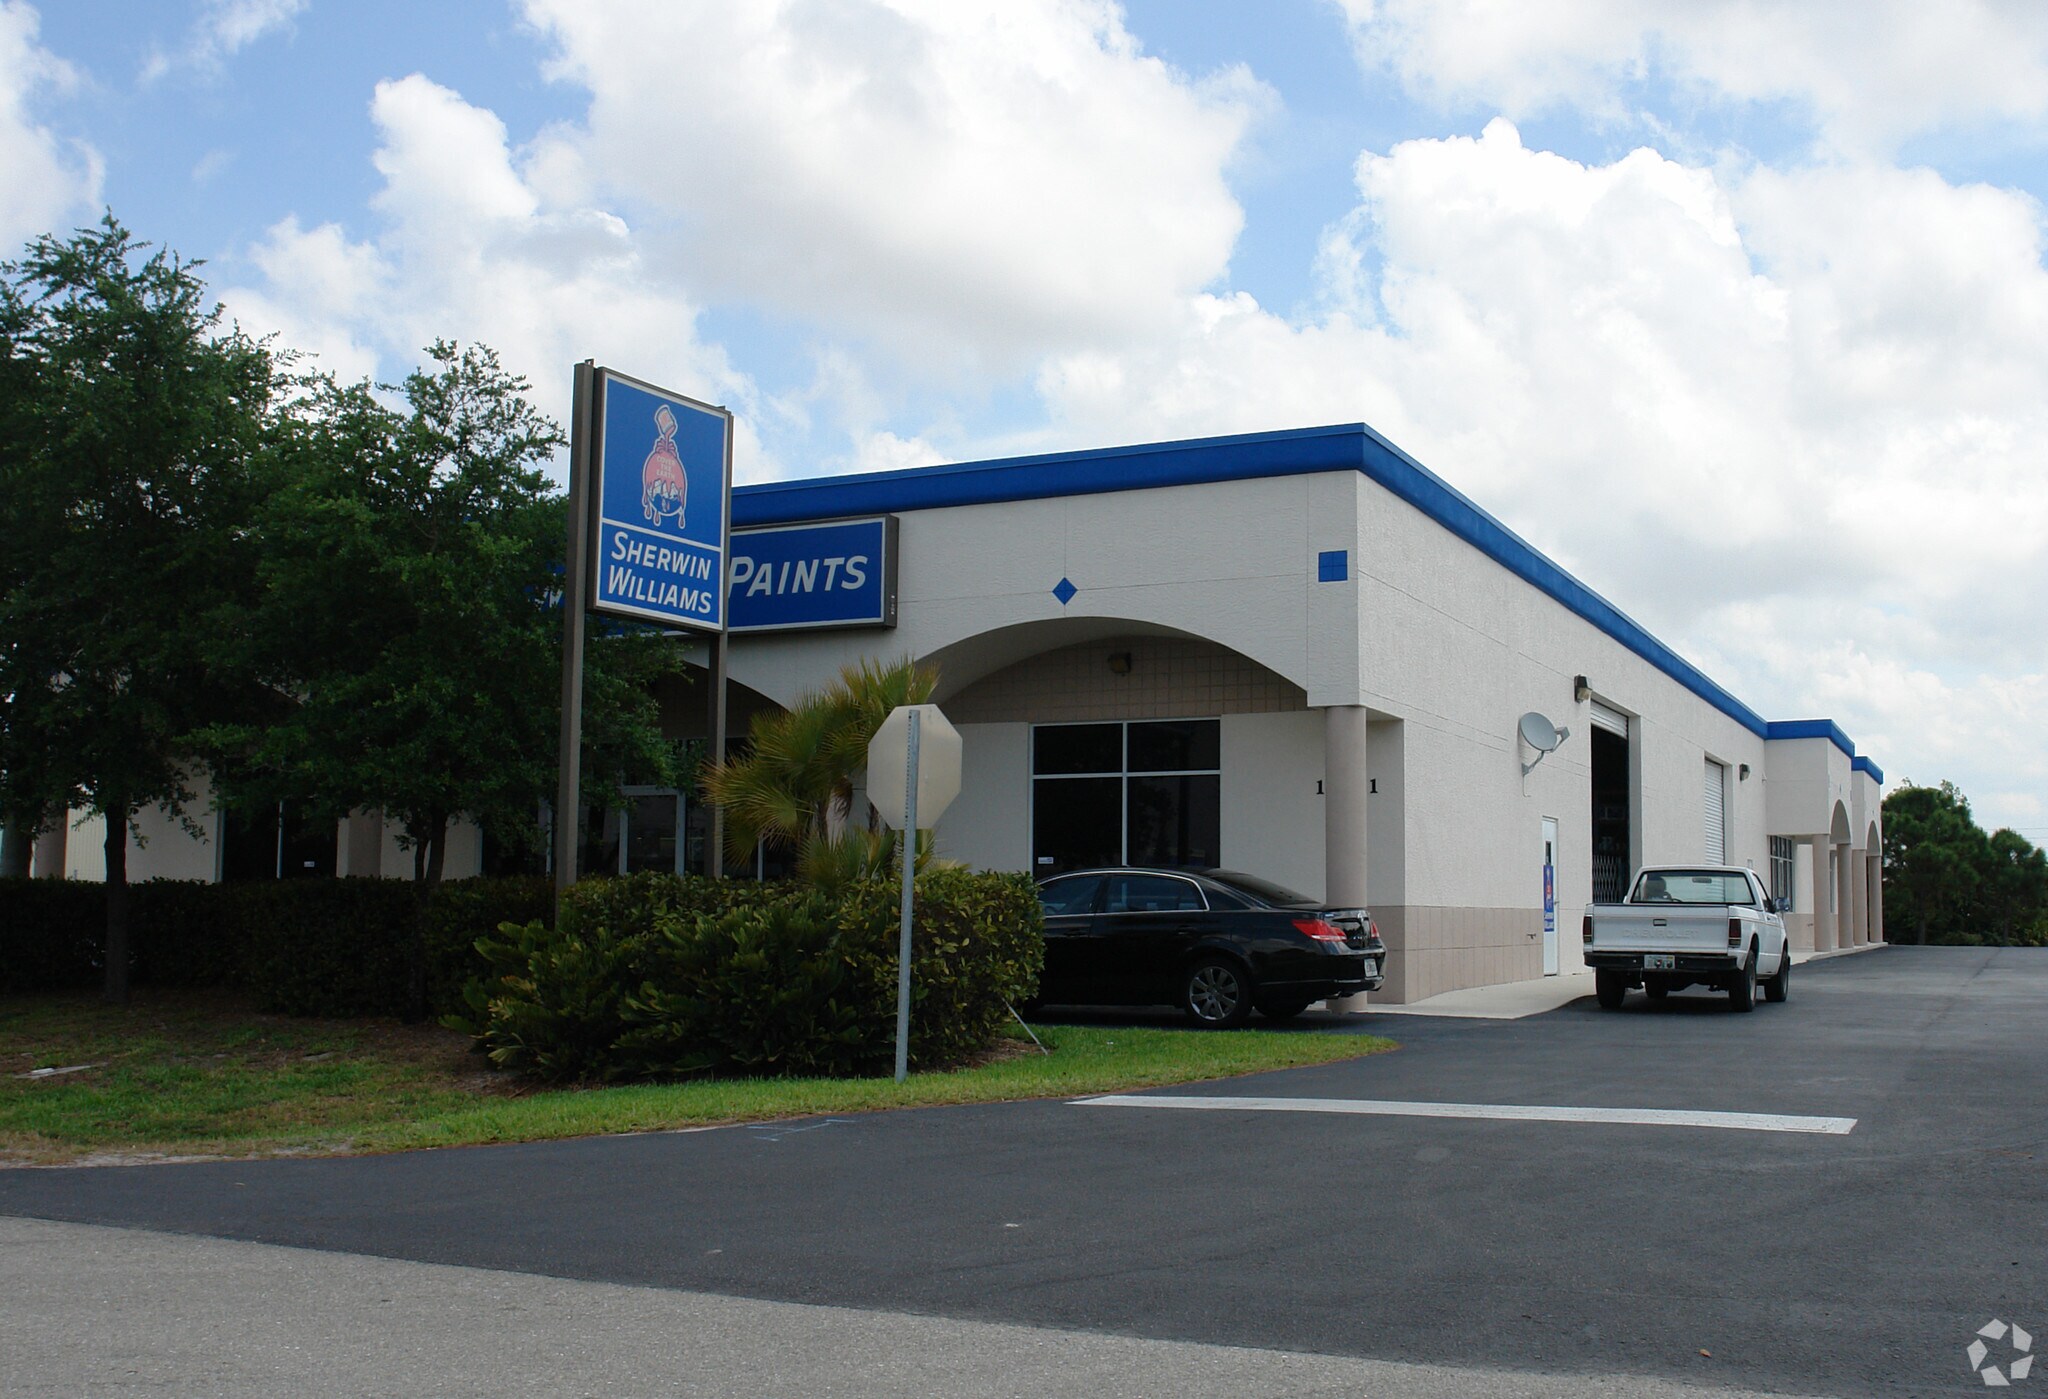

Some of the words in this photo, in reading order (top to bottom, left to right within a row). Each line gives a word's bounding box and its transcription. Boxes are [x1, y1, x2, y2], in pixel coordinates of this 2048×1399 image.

[611, 531, 711, 580] SHERWIN
[728, 555, 868, 598] PAINTS
[608, 565, 712, 613] WILLIAMS
